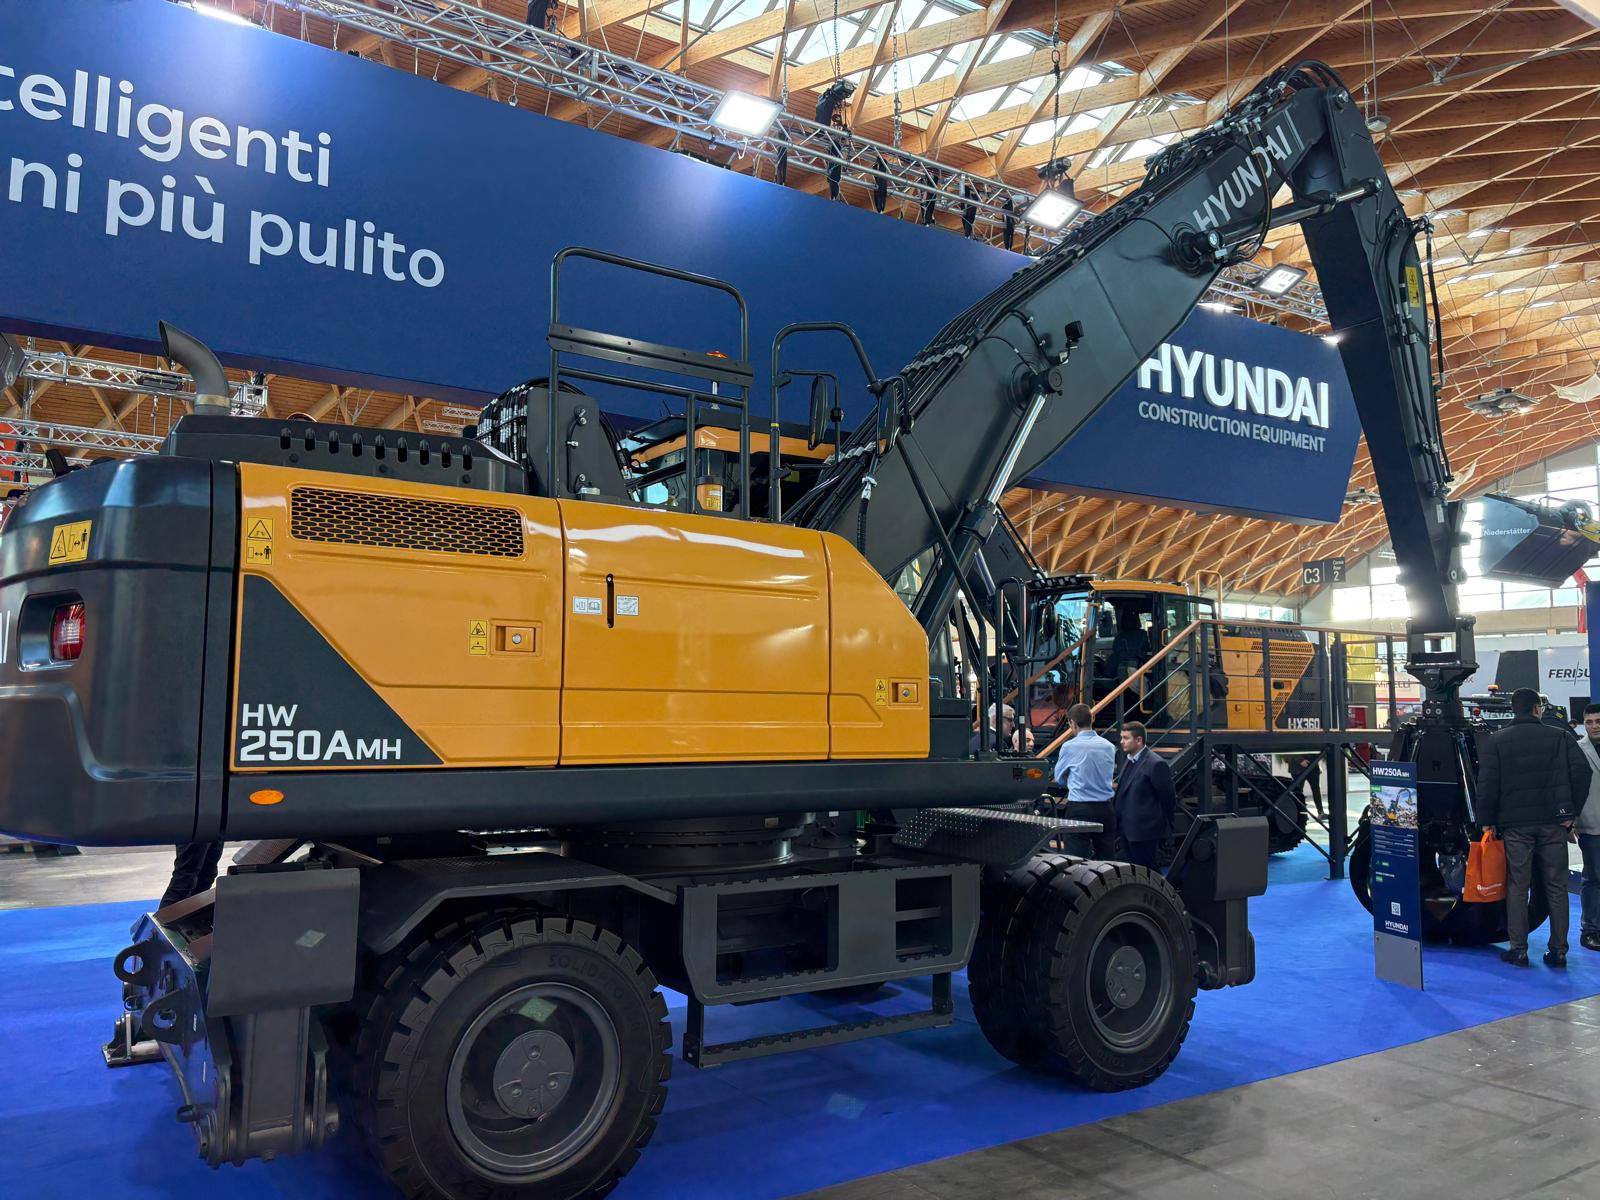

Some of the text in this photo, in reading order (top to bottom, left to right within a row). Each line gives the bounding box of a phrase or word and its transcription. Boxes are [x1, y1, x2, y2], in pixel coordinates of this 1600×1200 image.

[1192, 125, 1293, 232] HYUNDAI
[105, 174, 225, 244] più
[249, 210, 445, 288] pulito
[1137, 342, 1330, 429] HYUNDAI
[1138, 401, 1326, 452] CONSTRUCTION EQUIPMENT
[1303, 567, 1320, 584] C3
[1333, 570, 1340, 582] 2
[242, 703, 298, 727] HW
[1287, 717, 1320, 730] HX360
[1384, 920, 1409, 931] HYUNDAI
